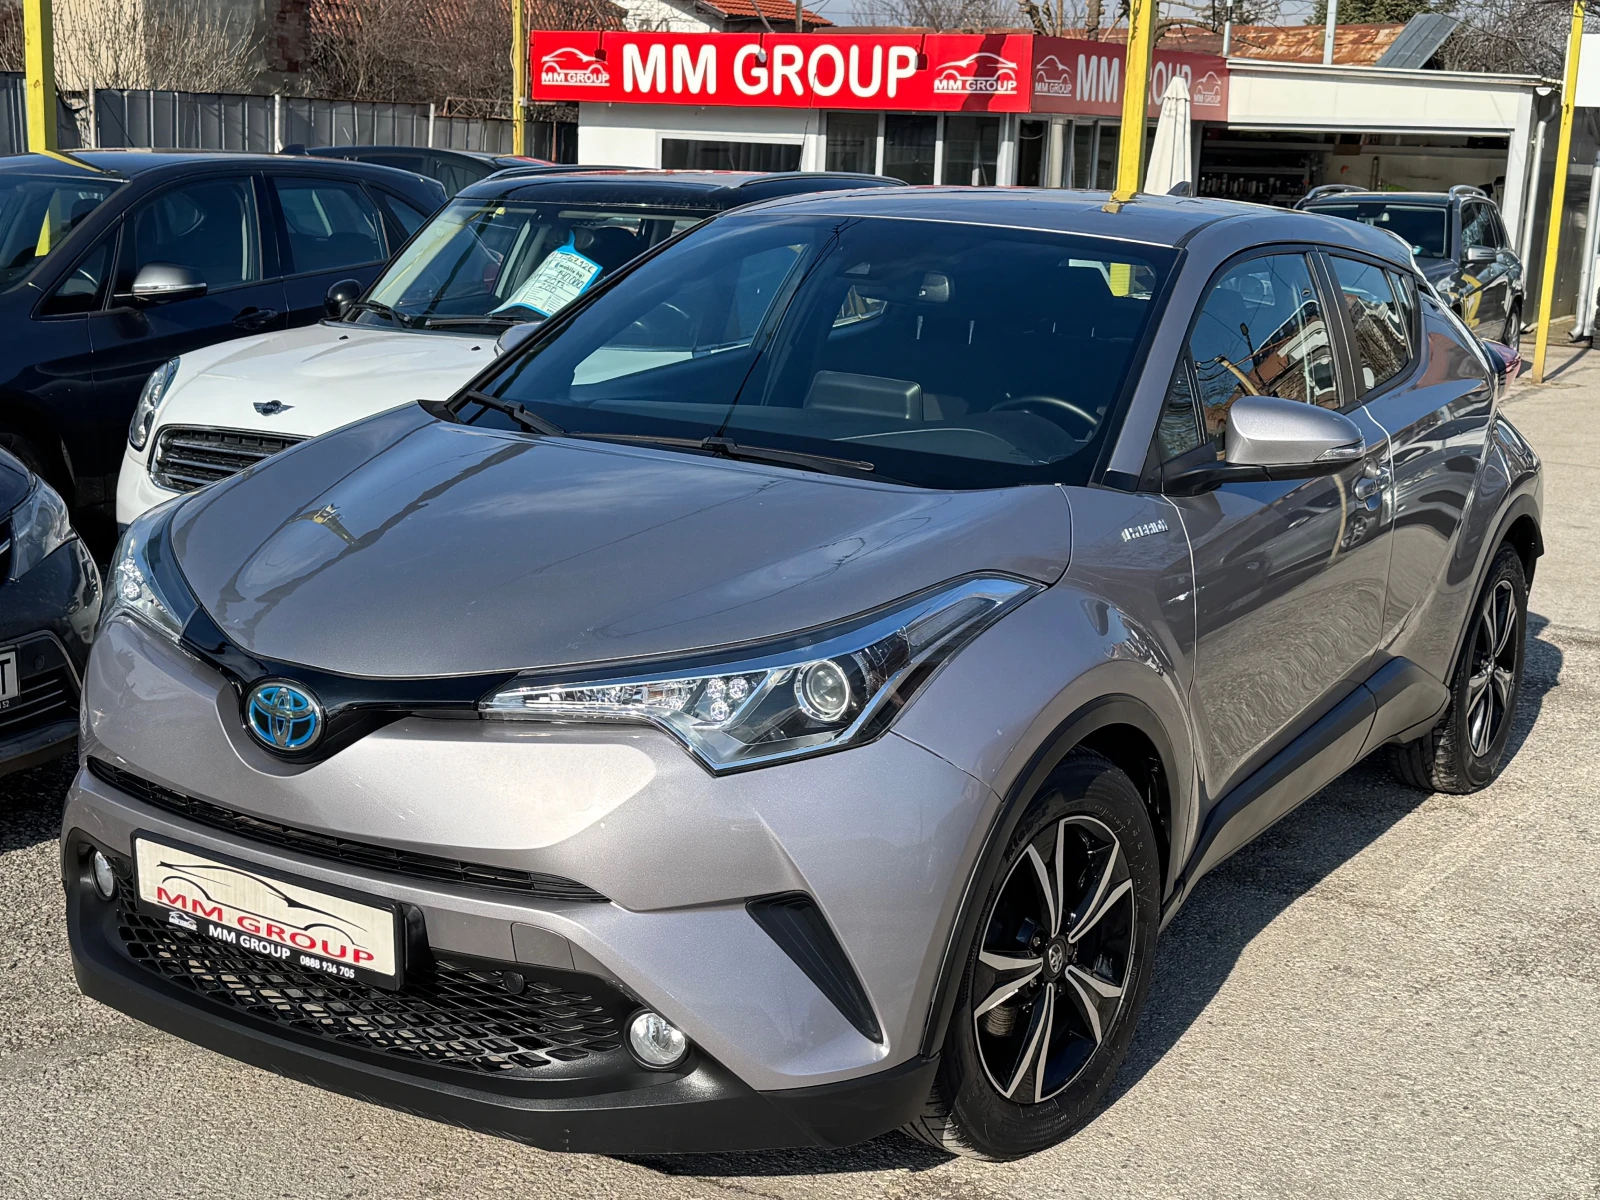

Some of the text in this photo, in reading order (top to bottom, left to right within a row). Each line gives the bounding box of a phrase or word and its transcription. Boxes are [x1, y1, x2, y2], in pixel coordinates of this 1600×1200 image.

[541, 72, 610, 84] MM GROUP
[622, 43, 918, 98] MM GROUP
[934, 79, 1017, 92] MM GROUP
[1035, 82, 1072, 94] MM GROUP
[1076, 54, 1120, 103] MM
[157, 886, 374, 964] MM GROUP
[208, 924, 236, 944] MM
[240, 934, 291, 960] GROUP
[300, 955, 320, 970] 0888
[322, 961, 338, 974] 936
[339, 965, 355, 979] 705
